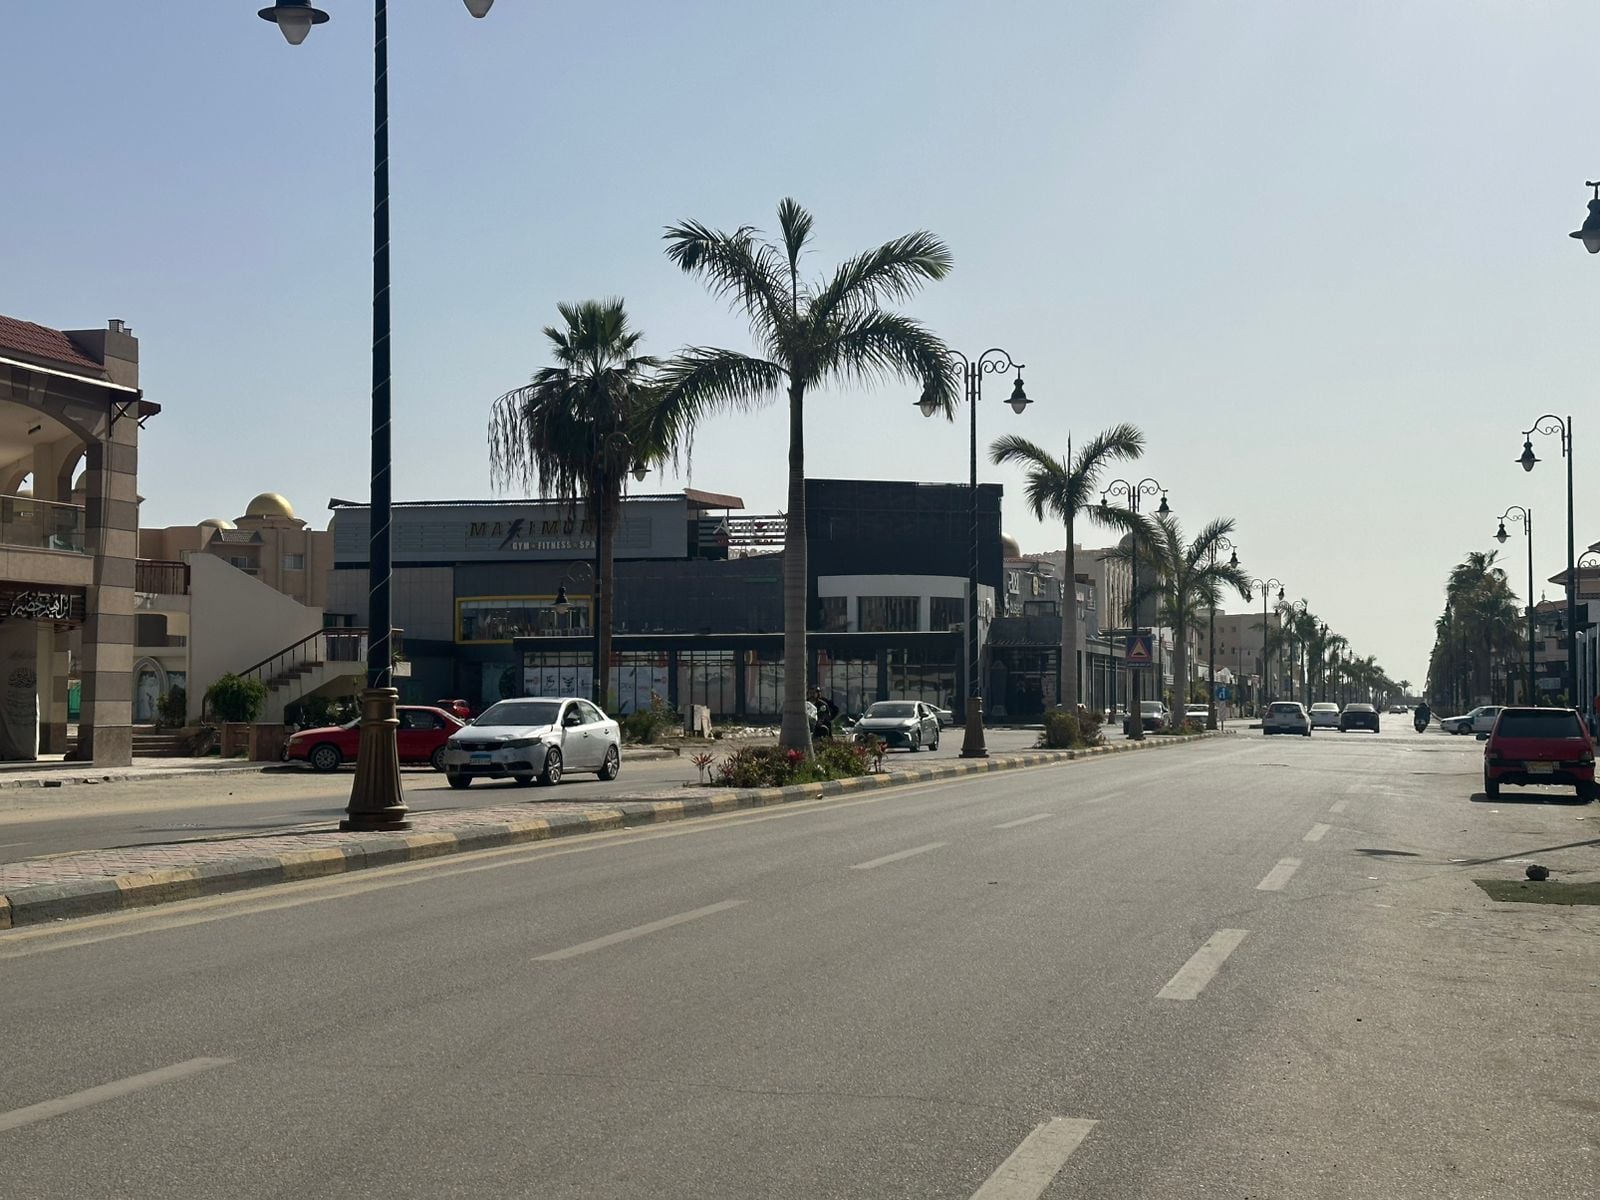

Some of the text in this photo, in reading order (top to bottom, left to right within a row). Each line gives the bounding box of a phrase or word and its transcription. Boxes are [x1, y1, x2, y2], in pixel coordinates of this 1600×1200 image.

[512, 540, 596, 550] GYM FITNESS SPA
